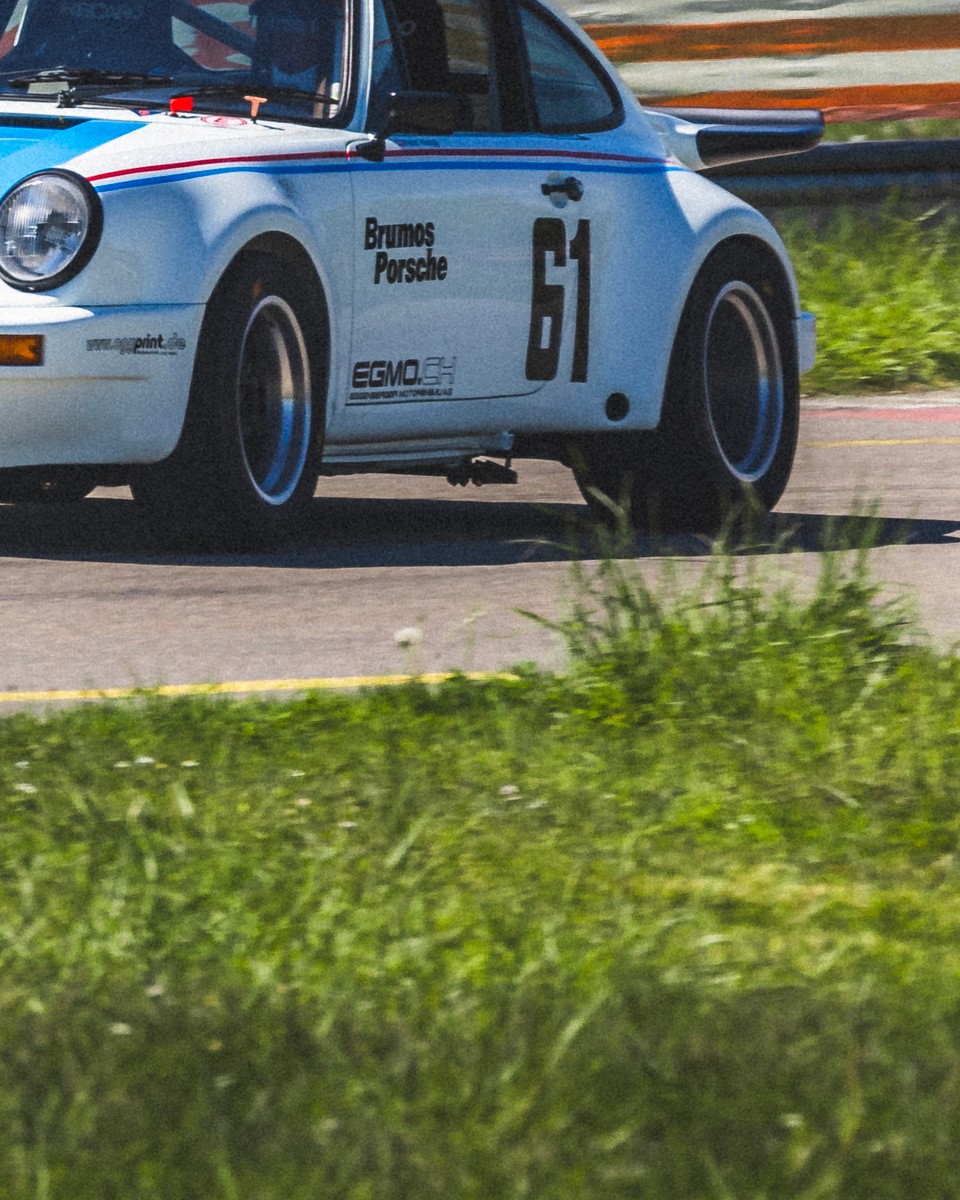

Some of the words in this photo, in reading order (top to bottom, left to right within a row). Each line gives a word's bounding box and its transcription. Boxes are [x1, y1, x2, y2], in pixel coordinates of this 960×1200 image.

[364, 216, 435, 250] Brumos
[374, 248, 448, 285] Porsche
[525, 217, 591, 383] 61
[352, 356, 457, 388] EGMO.CH
